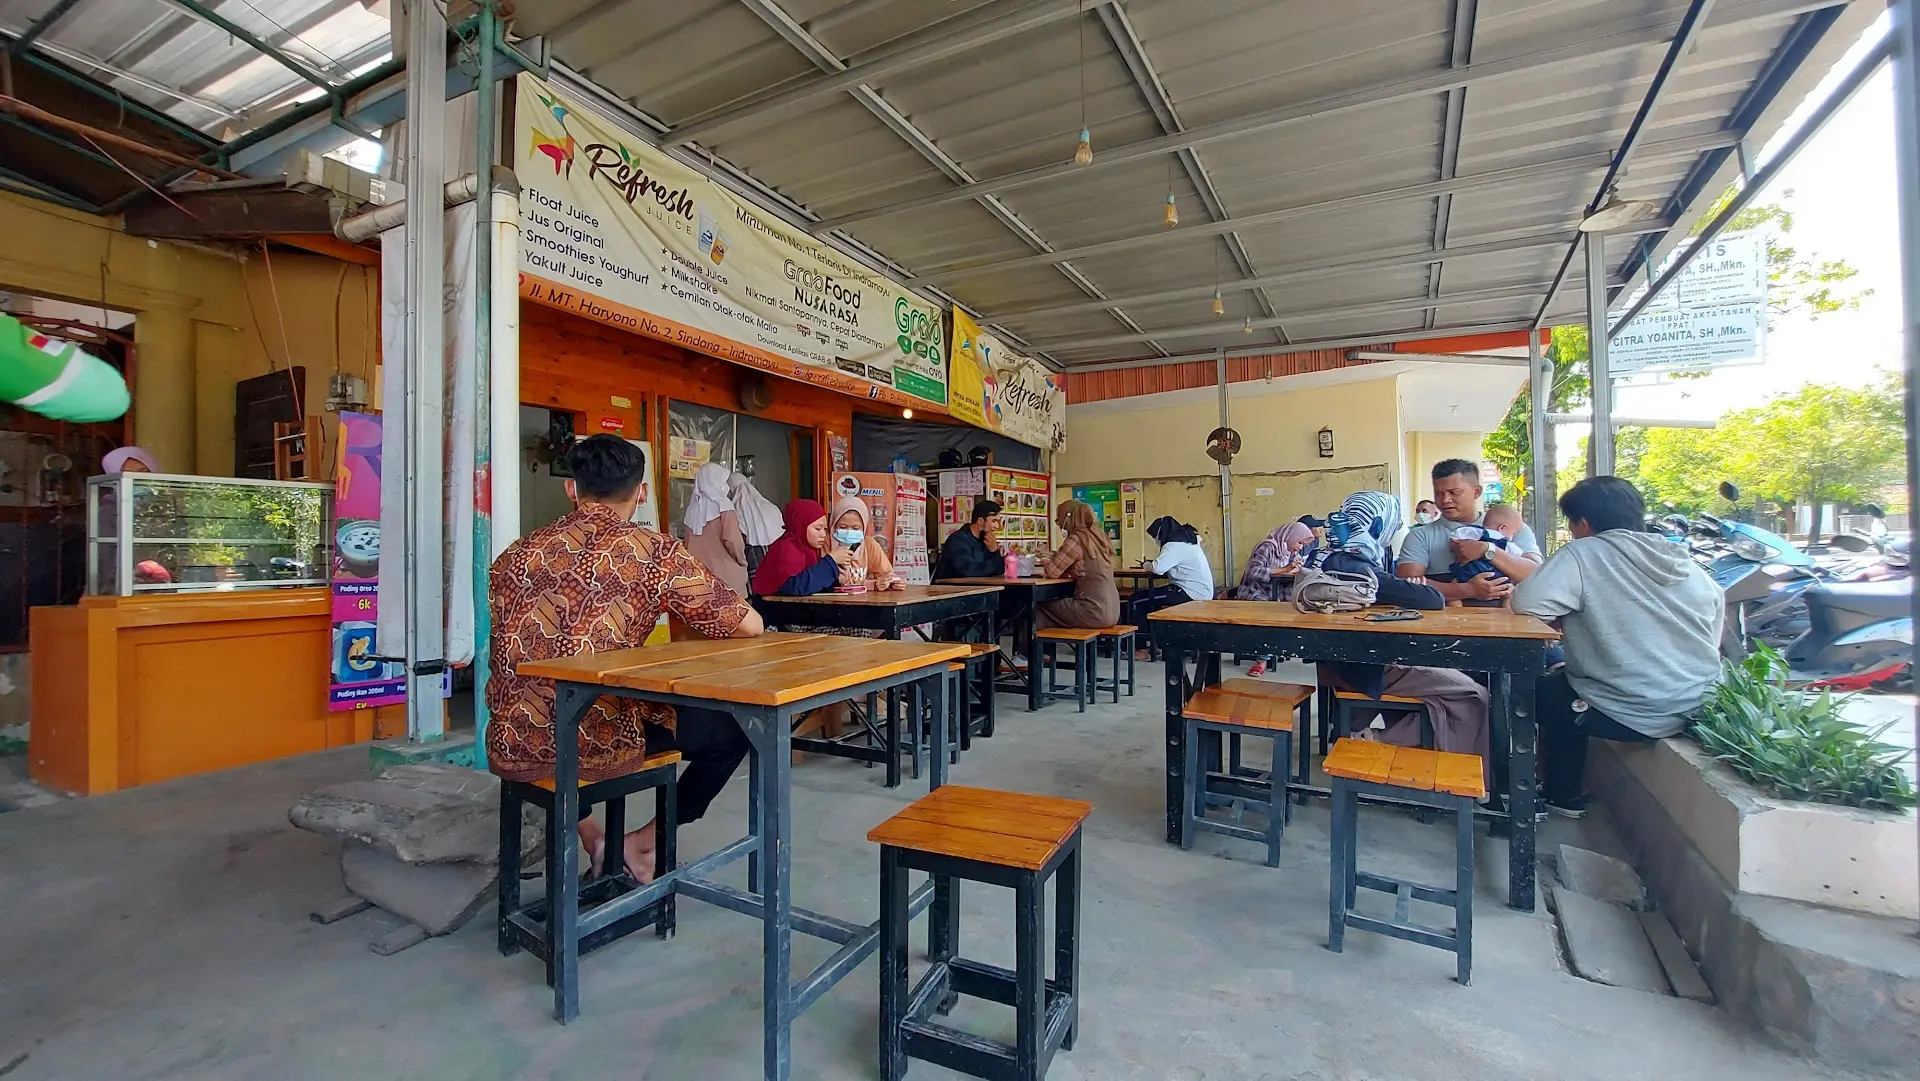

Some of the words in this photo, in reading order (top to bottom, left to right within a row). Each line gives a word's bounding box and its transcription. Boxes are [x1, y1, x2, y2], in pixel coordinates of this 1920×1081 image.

[585, 143, 694, 221] Refresh
[529, 188, 563, 212] Float
[566, 205, 600, 228] Juice
[647, 206, 692, 235] JUICE
[527, 210, 550, 228] Jus
[554, 220, 604, 250] Original
[524, 249, 567, 275] Yakult
[569, 267, 604, 288] Juice
[526, 229, 595, 265] Smoothies
[599, 256, 650, 286] Youghurt
[671, 252, 704, 275] Double
[705, 267, 729, 286] Juice
[736, 206, 787, 245] Minuman
[788, 235, 806, 252] No.
[811, 248, 843, 272] Terlaris
[853, 270, 891, 297] Indramayu
[671, 267, 718, 296] Milkshake
[784, 258, 861, 310] GrabFood
[670, 284, 711, 309] Cemilan
[713, 301, 755, 326] Otak-otak
[757, 318, 779, 335] Mafia
[745, 286, 777, 307] Nikmati
[779, 299, 829, 329] Santapannya,
[830, 321, 850, 337] Cepat
[794, 286, 860, 327] NUSARASA
[895, 296, 941, 346] Grab
[1693, 310, 1717, 320] AKTA
[1720, 306, 1751, 316] TANAH
[529, 283, 543, 298] Jl.
[548, 289, 575, 309] MT.
[579, 299, 637, 328] Haryono
[640, 318, 661, 335] No.
[664, 327, 673, 340] 2,
[677, 330, 721, 353] Sindang
[730, 345, 779, 370] Indramayu
[757, 333, 787, 351] Download
[1613, 335, 1644, 347] CITRA
[1647, 330, 1696, 344] YOANITA,
[861, 488, 884, 496] MENU
[340, 585, 359, 594] Puding
[358, 598, 371, 610] 6k
[337, 690, 356, 698] Puding
[356, 688, 368, 696] Ikan
[368, 686, 385, 695] 200ml
